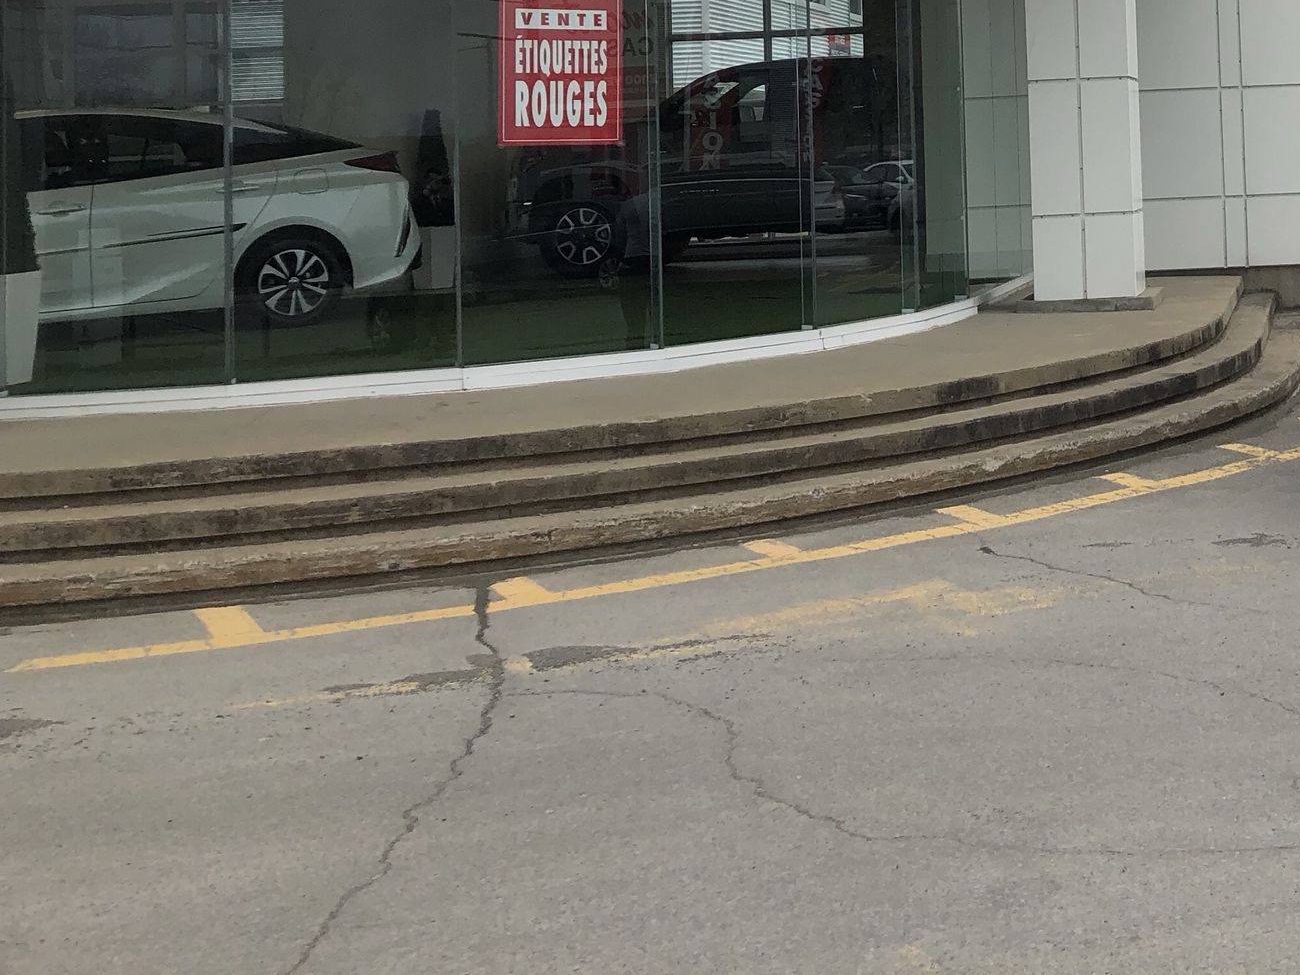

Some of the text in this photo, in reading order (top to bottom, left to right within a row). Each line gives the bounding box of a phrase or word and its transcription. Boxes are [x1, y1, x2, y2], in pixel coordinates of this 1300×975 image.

[520, 11, 603, 27] VENTE
[515, 35, 608, 77] ÉTIQUETTES
[515, 79, 608, 128] ROUGES
